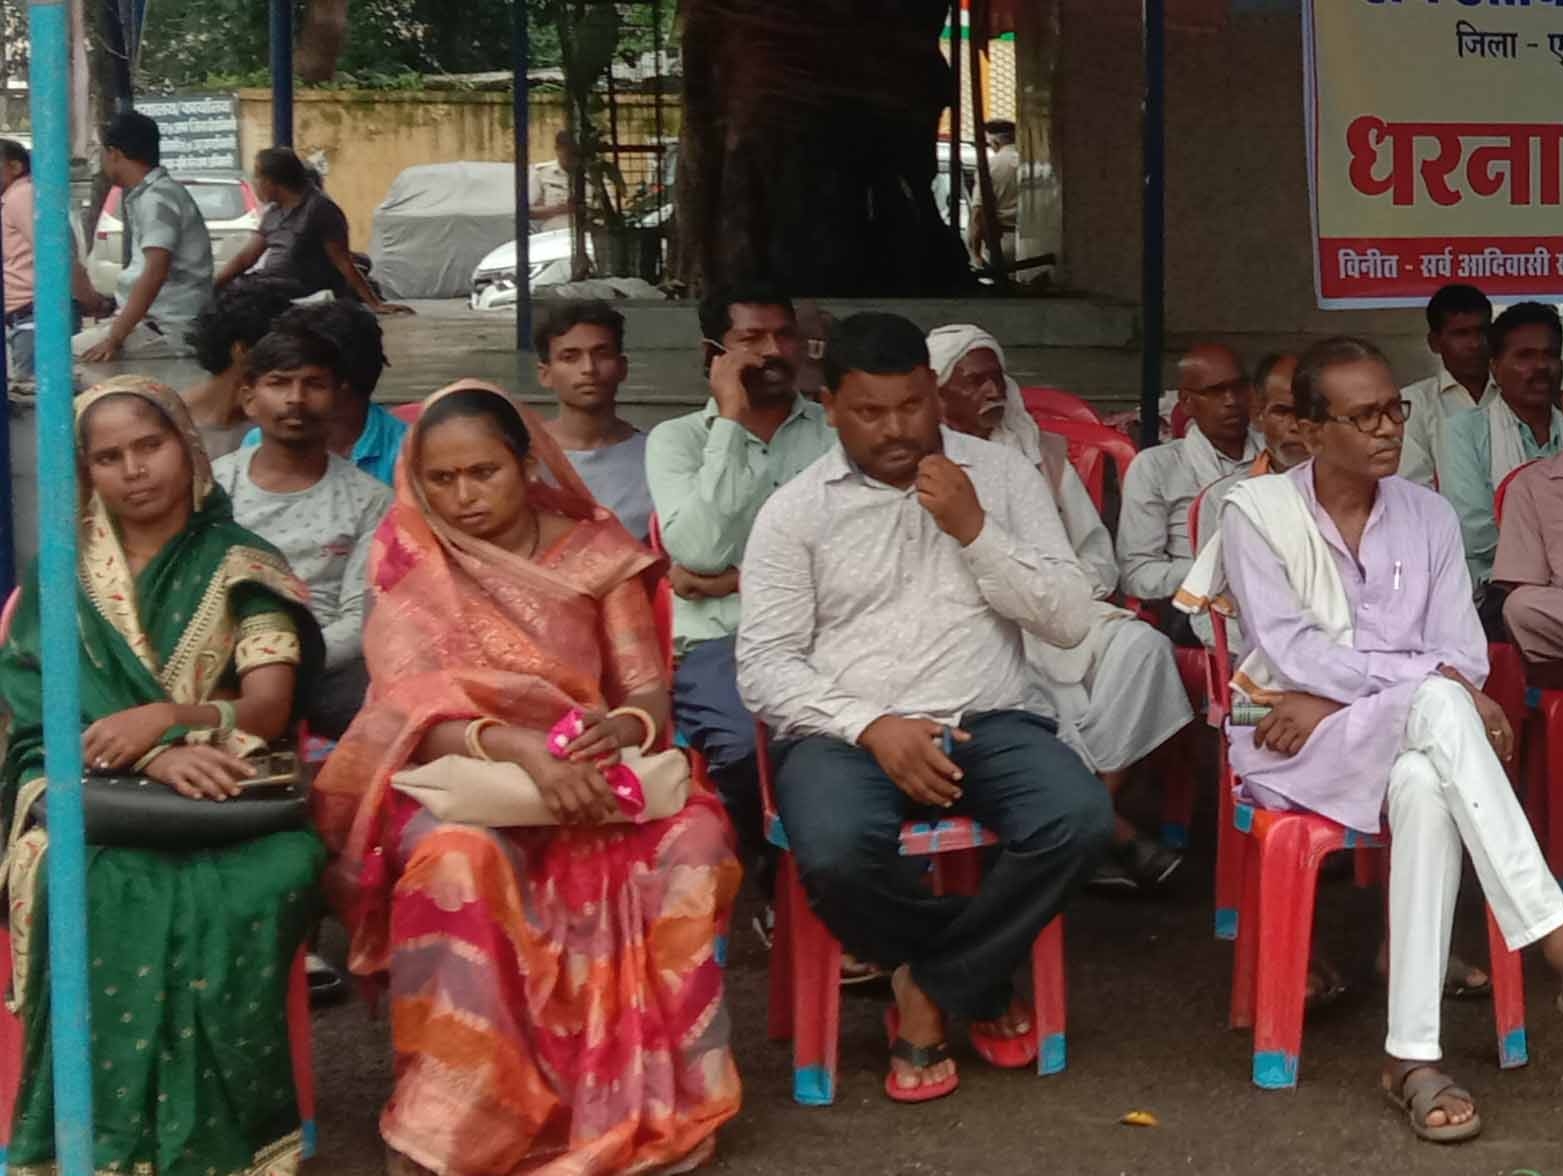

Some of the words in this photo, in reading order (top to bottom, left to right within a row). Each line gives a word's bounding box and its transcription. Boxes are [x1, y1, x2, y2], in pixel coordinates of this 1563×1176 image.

[1456, 20, 1518, 58] जिला
[1338, 248, 1399, 279] विनीत
[1420, 246, 1453, 278] सर्व
[1458, 246, 1549, 277] आदिवासी
